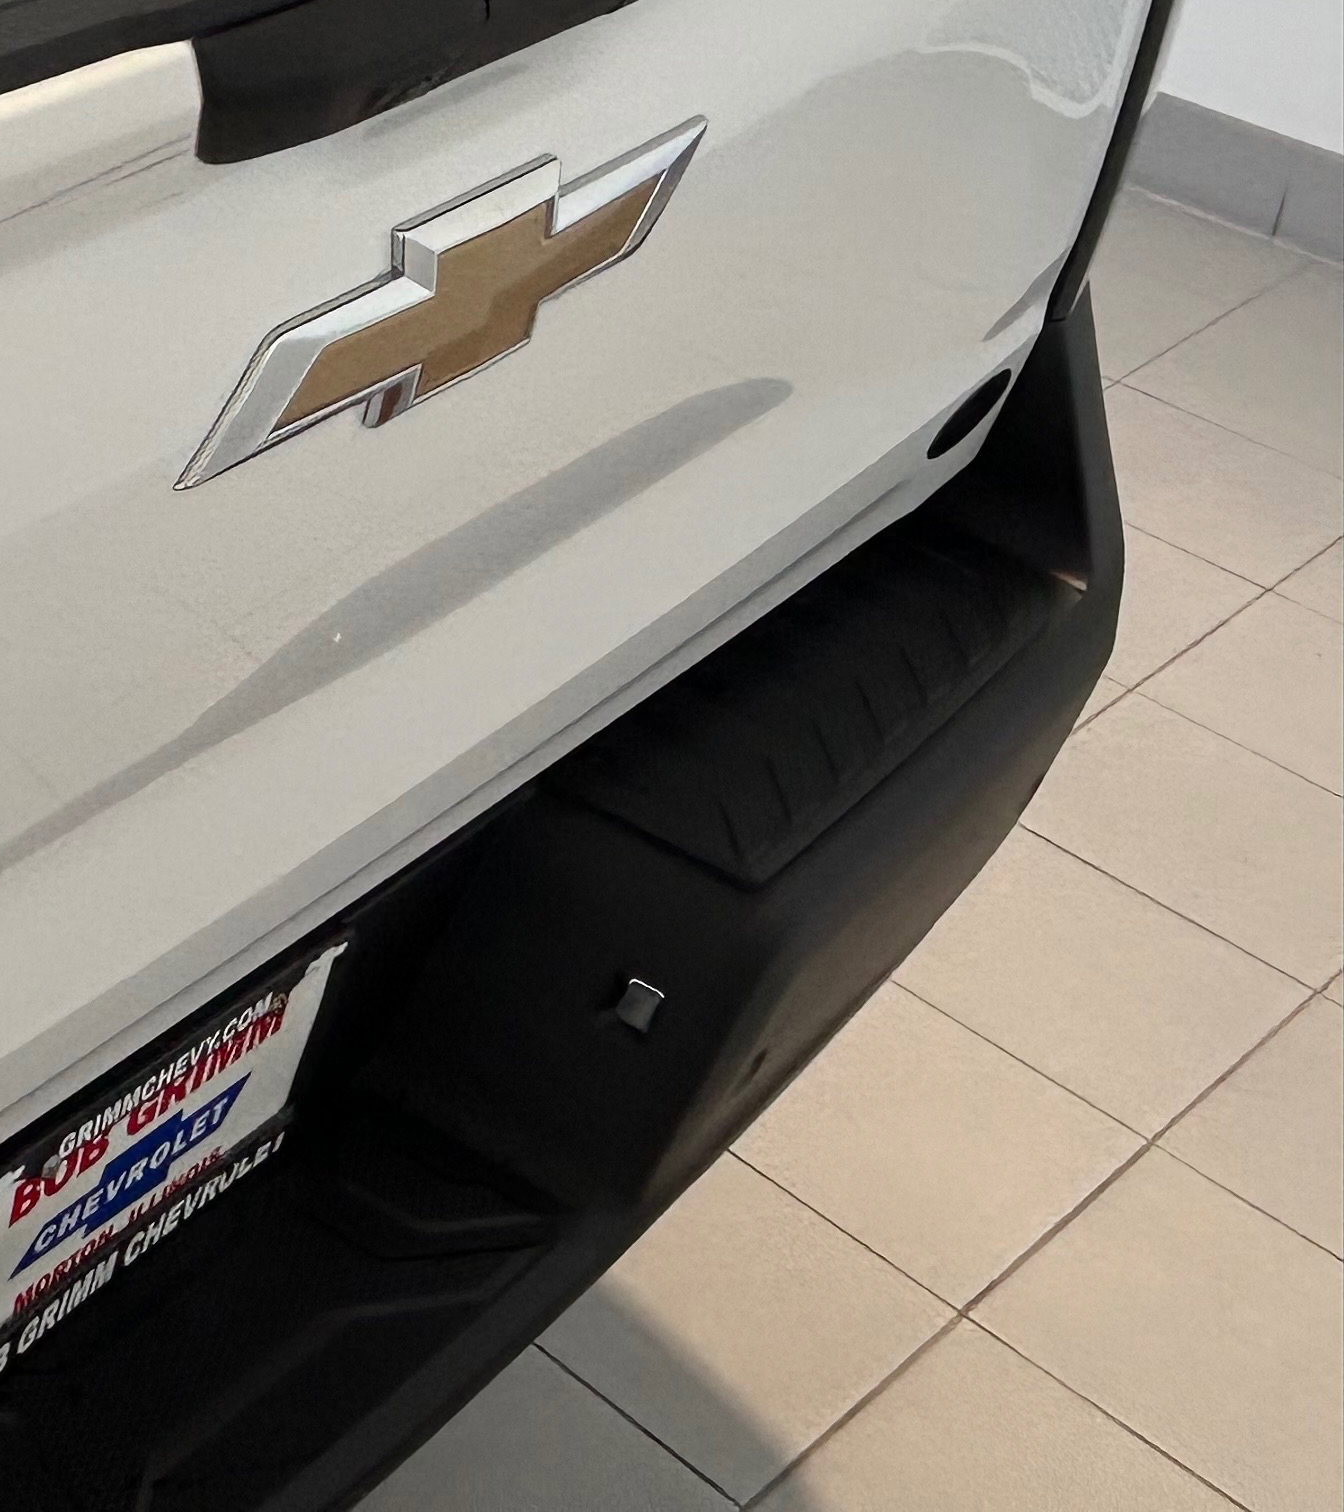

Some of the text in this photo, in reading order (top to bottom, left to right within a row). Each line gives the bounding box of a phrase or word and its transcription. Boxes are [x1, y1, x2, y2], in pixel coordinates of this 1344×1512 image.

[9, 1134, 110, 1228] BOB
[17, 1251, 119, 1355] GRIMM
[124, 1131, 286, 1267] CHEVROLET
[34, 1097, 230, 1254] CHEVROLET
